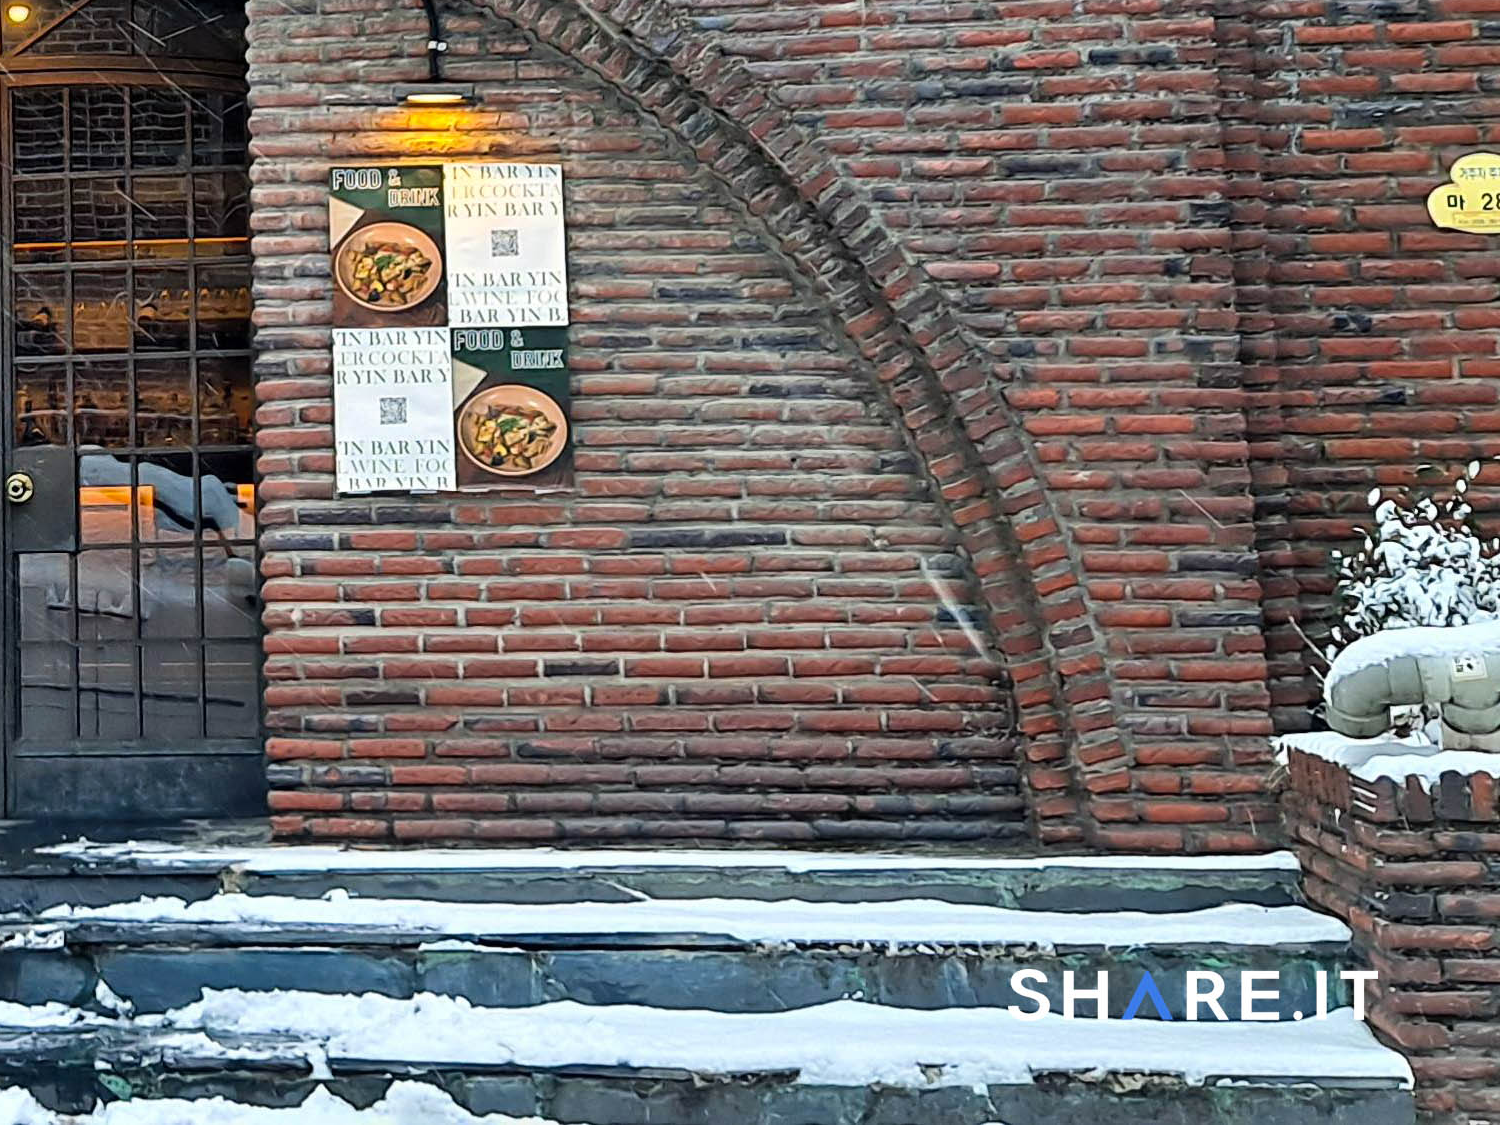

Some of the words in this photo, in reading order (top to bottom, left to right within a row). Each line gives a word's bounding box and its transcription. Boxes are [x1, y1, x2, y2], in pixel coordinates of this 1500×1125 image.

[481, 165, 518, 179] BAR
[332, 169, 382, 191] FOOD
[388, 169, 401, 187] &
[388, 188, 440, 207] DRINK
[1447, 195, 1465, 210] 마
[464, 203, 498, 217] YIN
[506, 202, 543, 216] BAR
[484, 272, 522, 287] BAR
[528, 271, 562, 286] YIN
[461, 308, 499, 323] BAR
[507, 307, 541, 322] YIN
[549, 307, 565, 321] B
[369, 331, 407, 345] BAR
[414, 330, 449, 344] YIN
[454, 329, 504, 351] FOOD
[510, 329, 524, 347] &
[510, 349, 564, 369] DRINK
[353, 370, 388, 384] YIN
[394, 369, 432, 383] BAR
[371, 440, 410, 454] BAR
[416, 439, 450, 454] YIN
